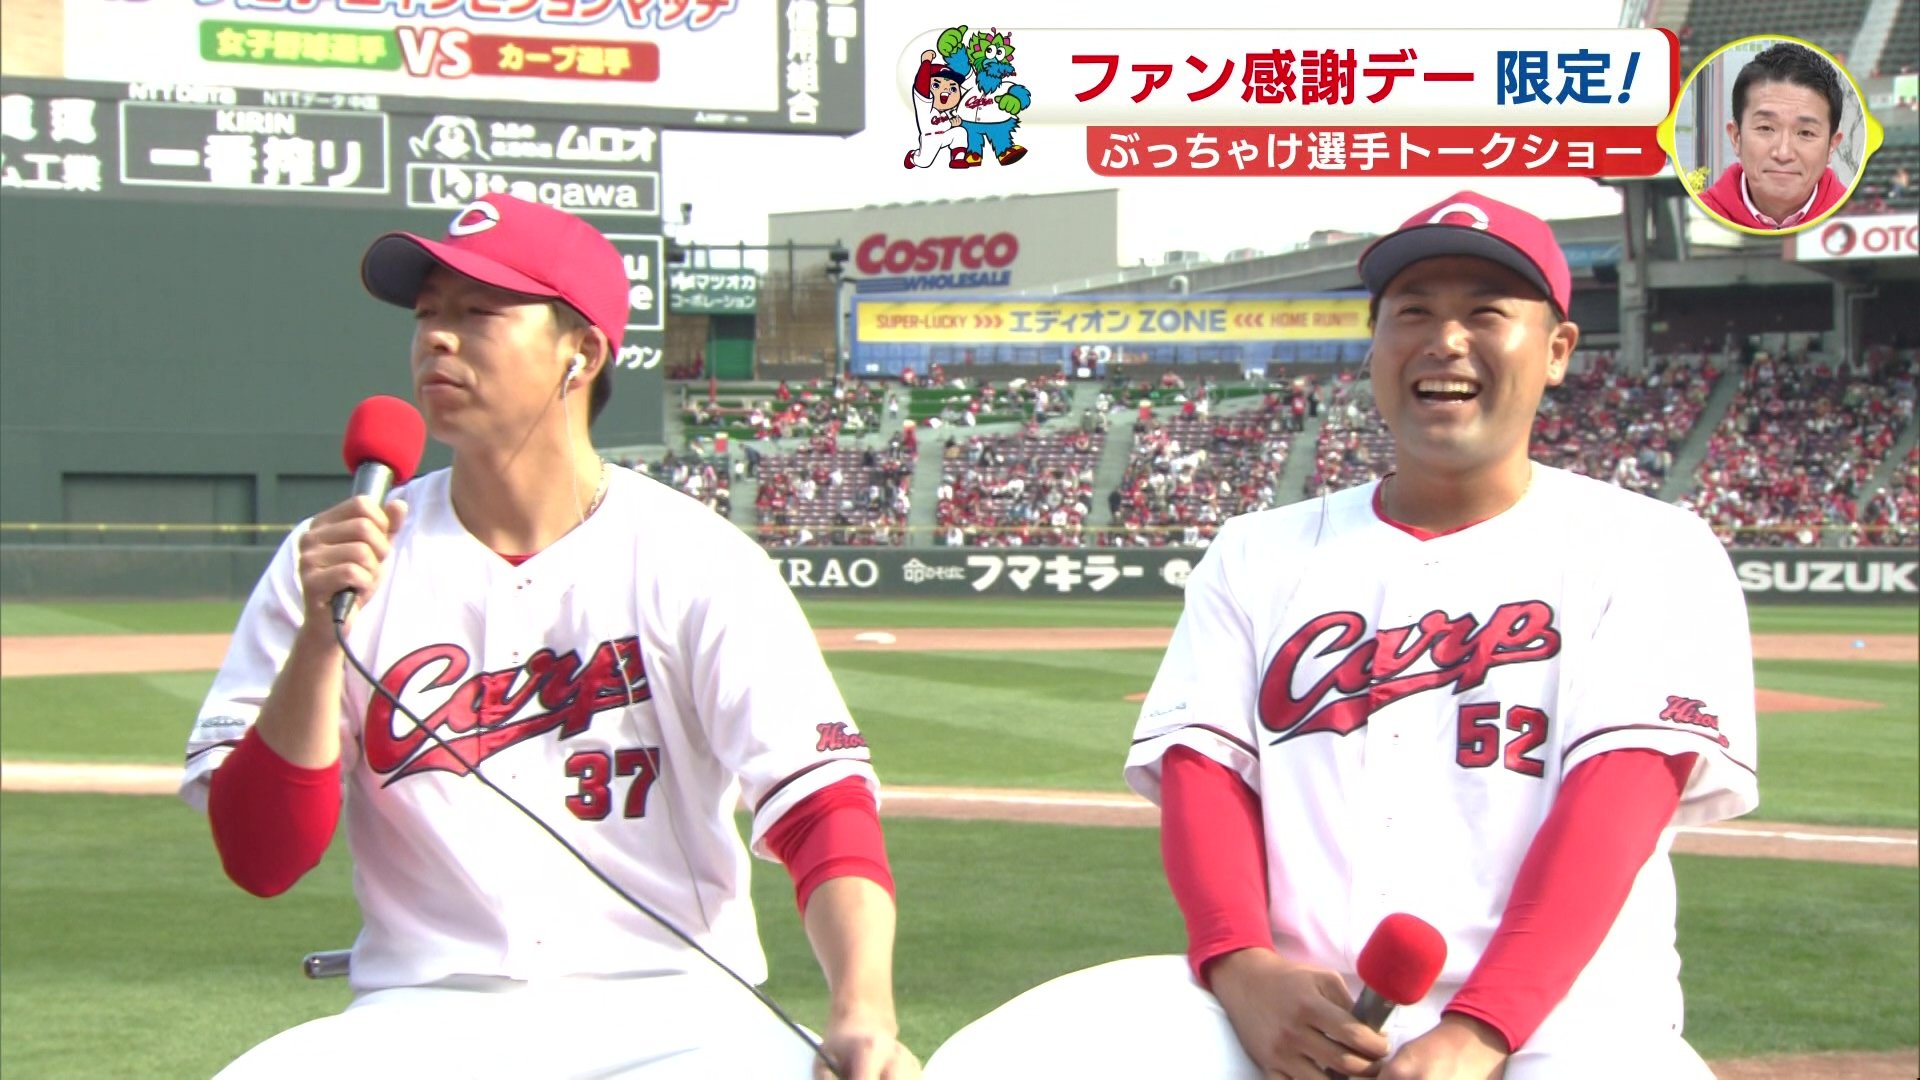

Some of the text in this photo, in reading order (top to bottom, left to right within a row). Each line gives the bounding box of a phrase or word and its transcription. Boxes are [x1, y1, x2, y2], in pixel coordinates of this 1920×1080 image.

[396, 26, 474, 79] VS
[498, 43, 631, 76] カープ選手
[216, 110, 296, 135] KIRIN
[556, 124, 657, 162] ムロオ
[905, 271, 1012, 293] WHOLESALE
[672, 294, 756, 309] コーポレーション
[877, 314, 967, 329] SUPER-LUCKY
[1009, 310, 1131, 333] エディオン
[1139, 309, 1227, 332] ZONE
[1271, 312, 1308, 328] HOME
[967, 555, 1144, 592] フマキラー
[1258, 600, 1561, 746] Carp
[364, 636, 651, 789] Carp
[1456, 701, 1549, 778] 52
[565, 748, 660, 821] 37
